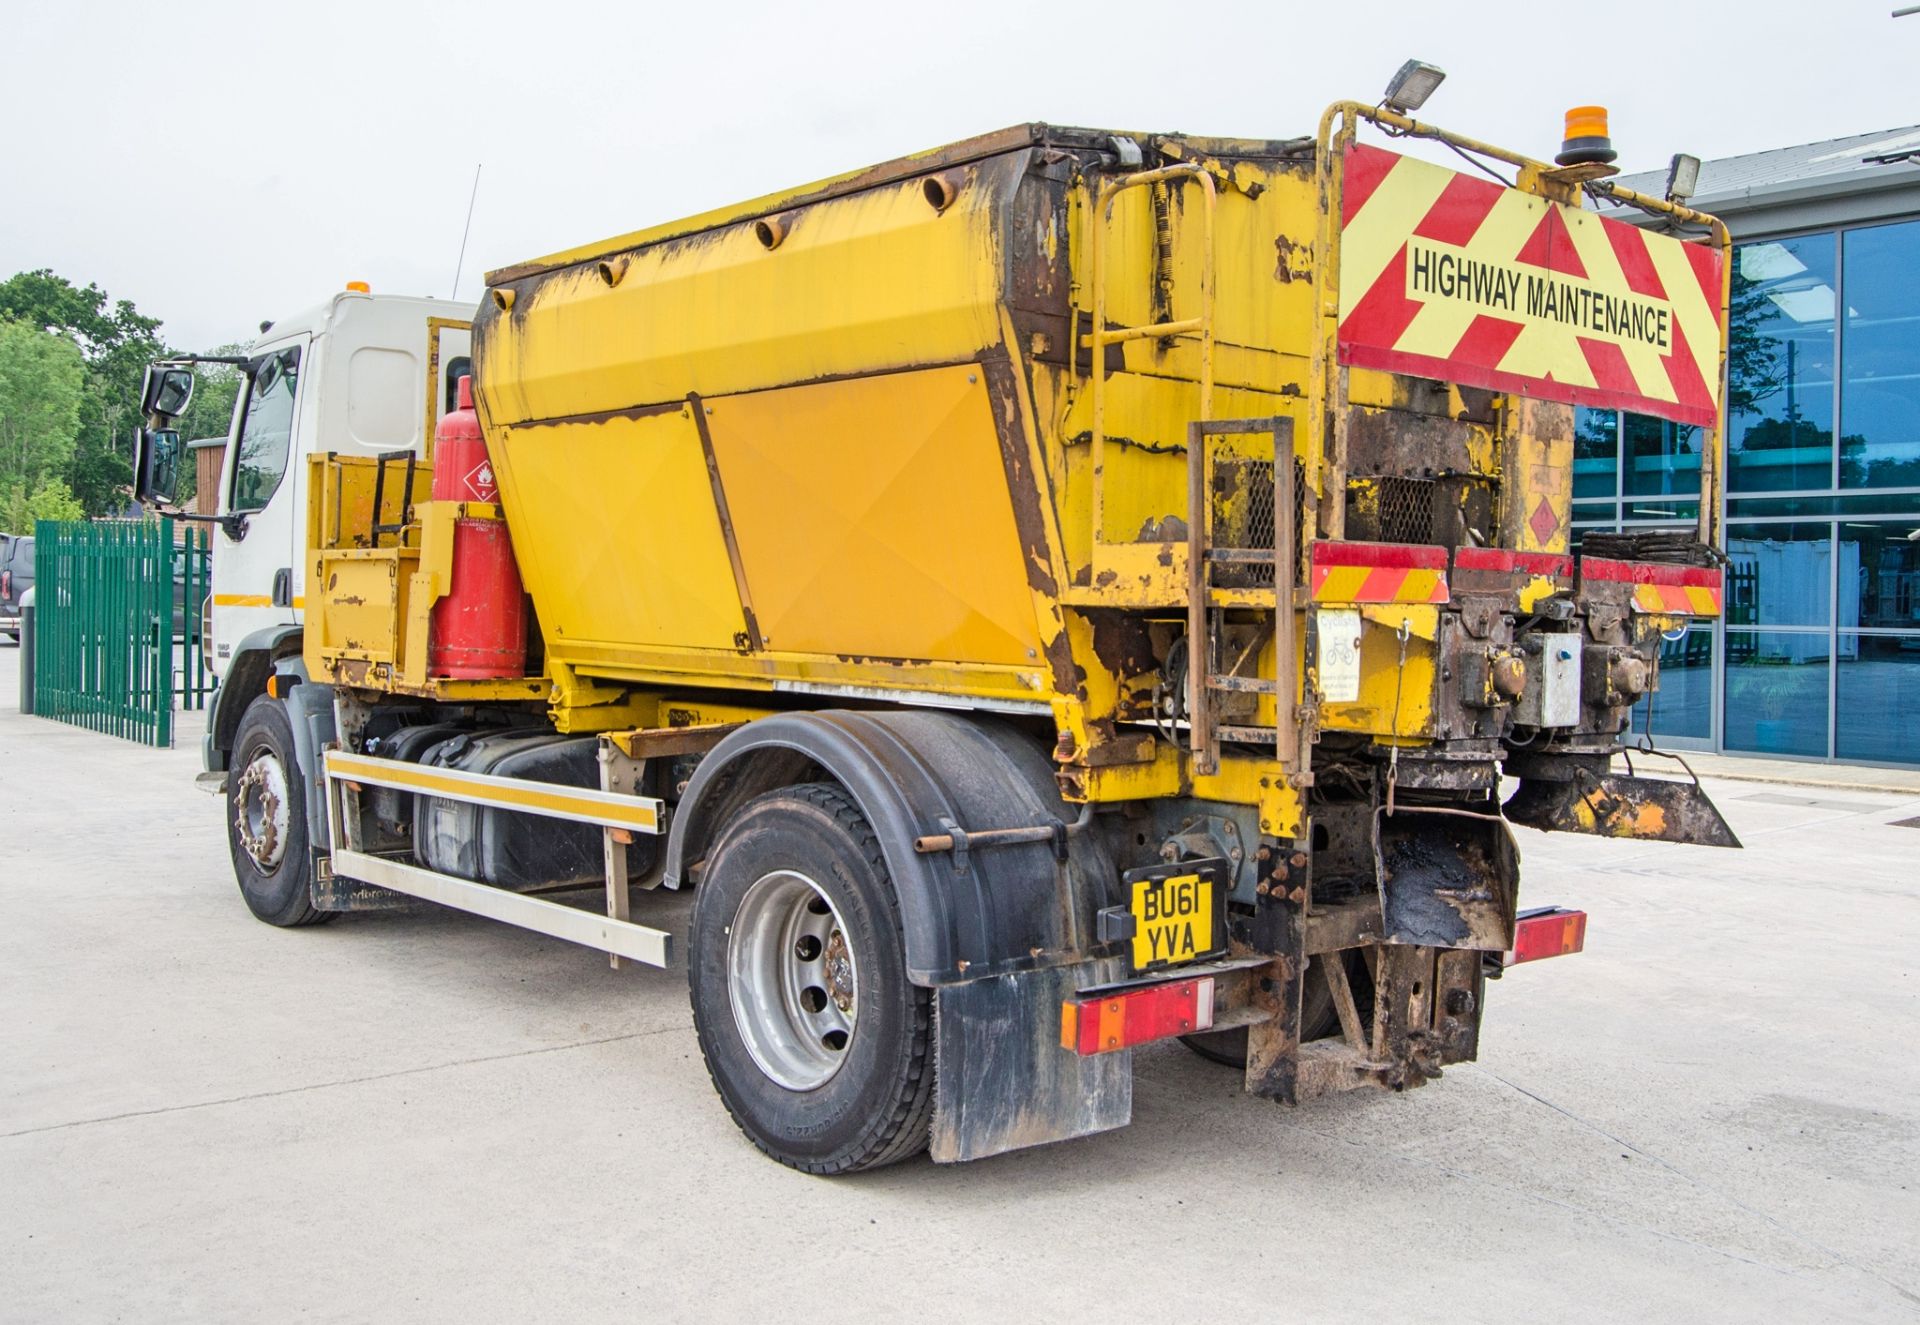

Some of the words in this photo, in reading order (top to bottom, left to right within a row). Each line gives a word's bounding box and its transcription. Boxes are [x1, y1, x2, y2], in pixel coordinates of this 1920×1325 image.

[1413, 247, 1521, 311] HIGHWAY
[1527, 275, 1668, 347] MAINTENANCE
[1144, 882, 1199, 921] BU61
[1147, 922, 1195, 961] YVA
